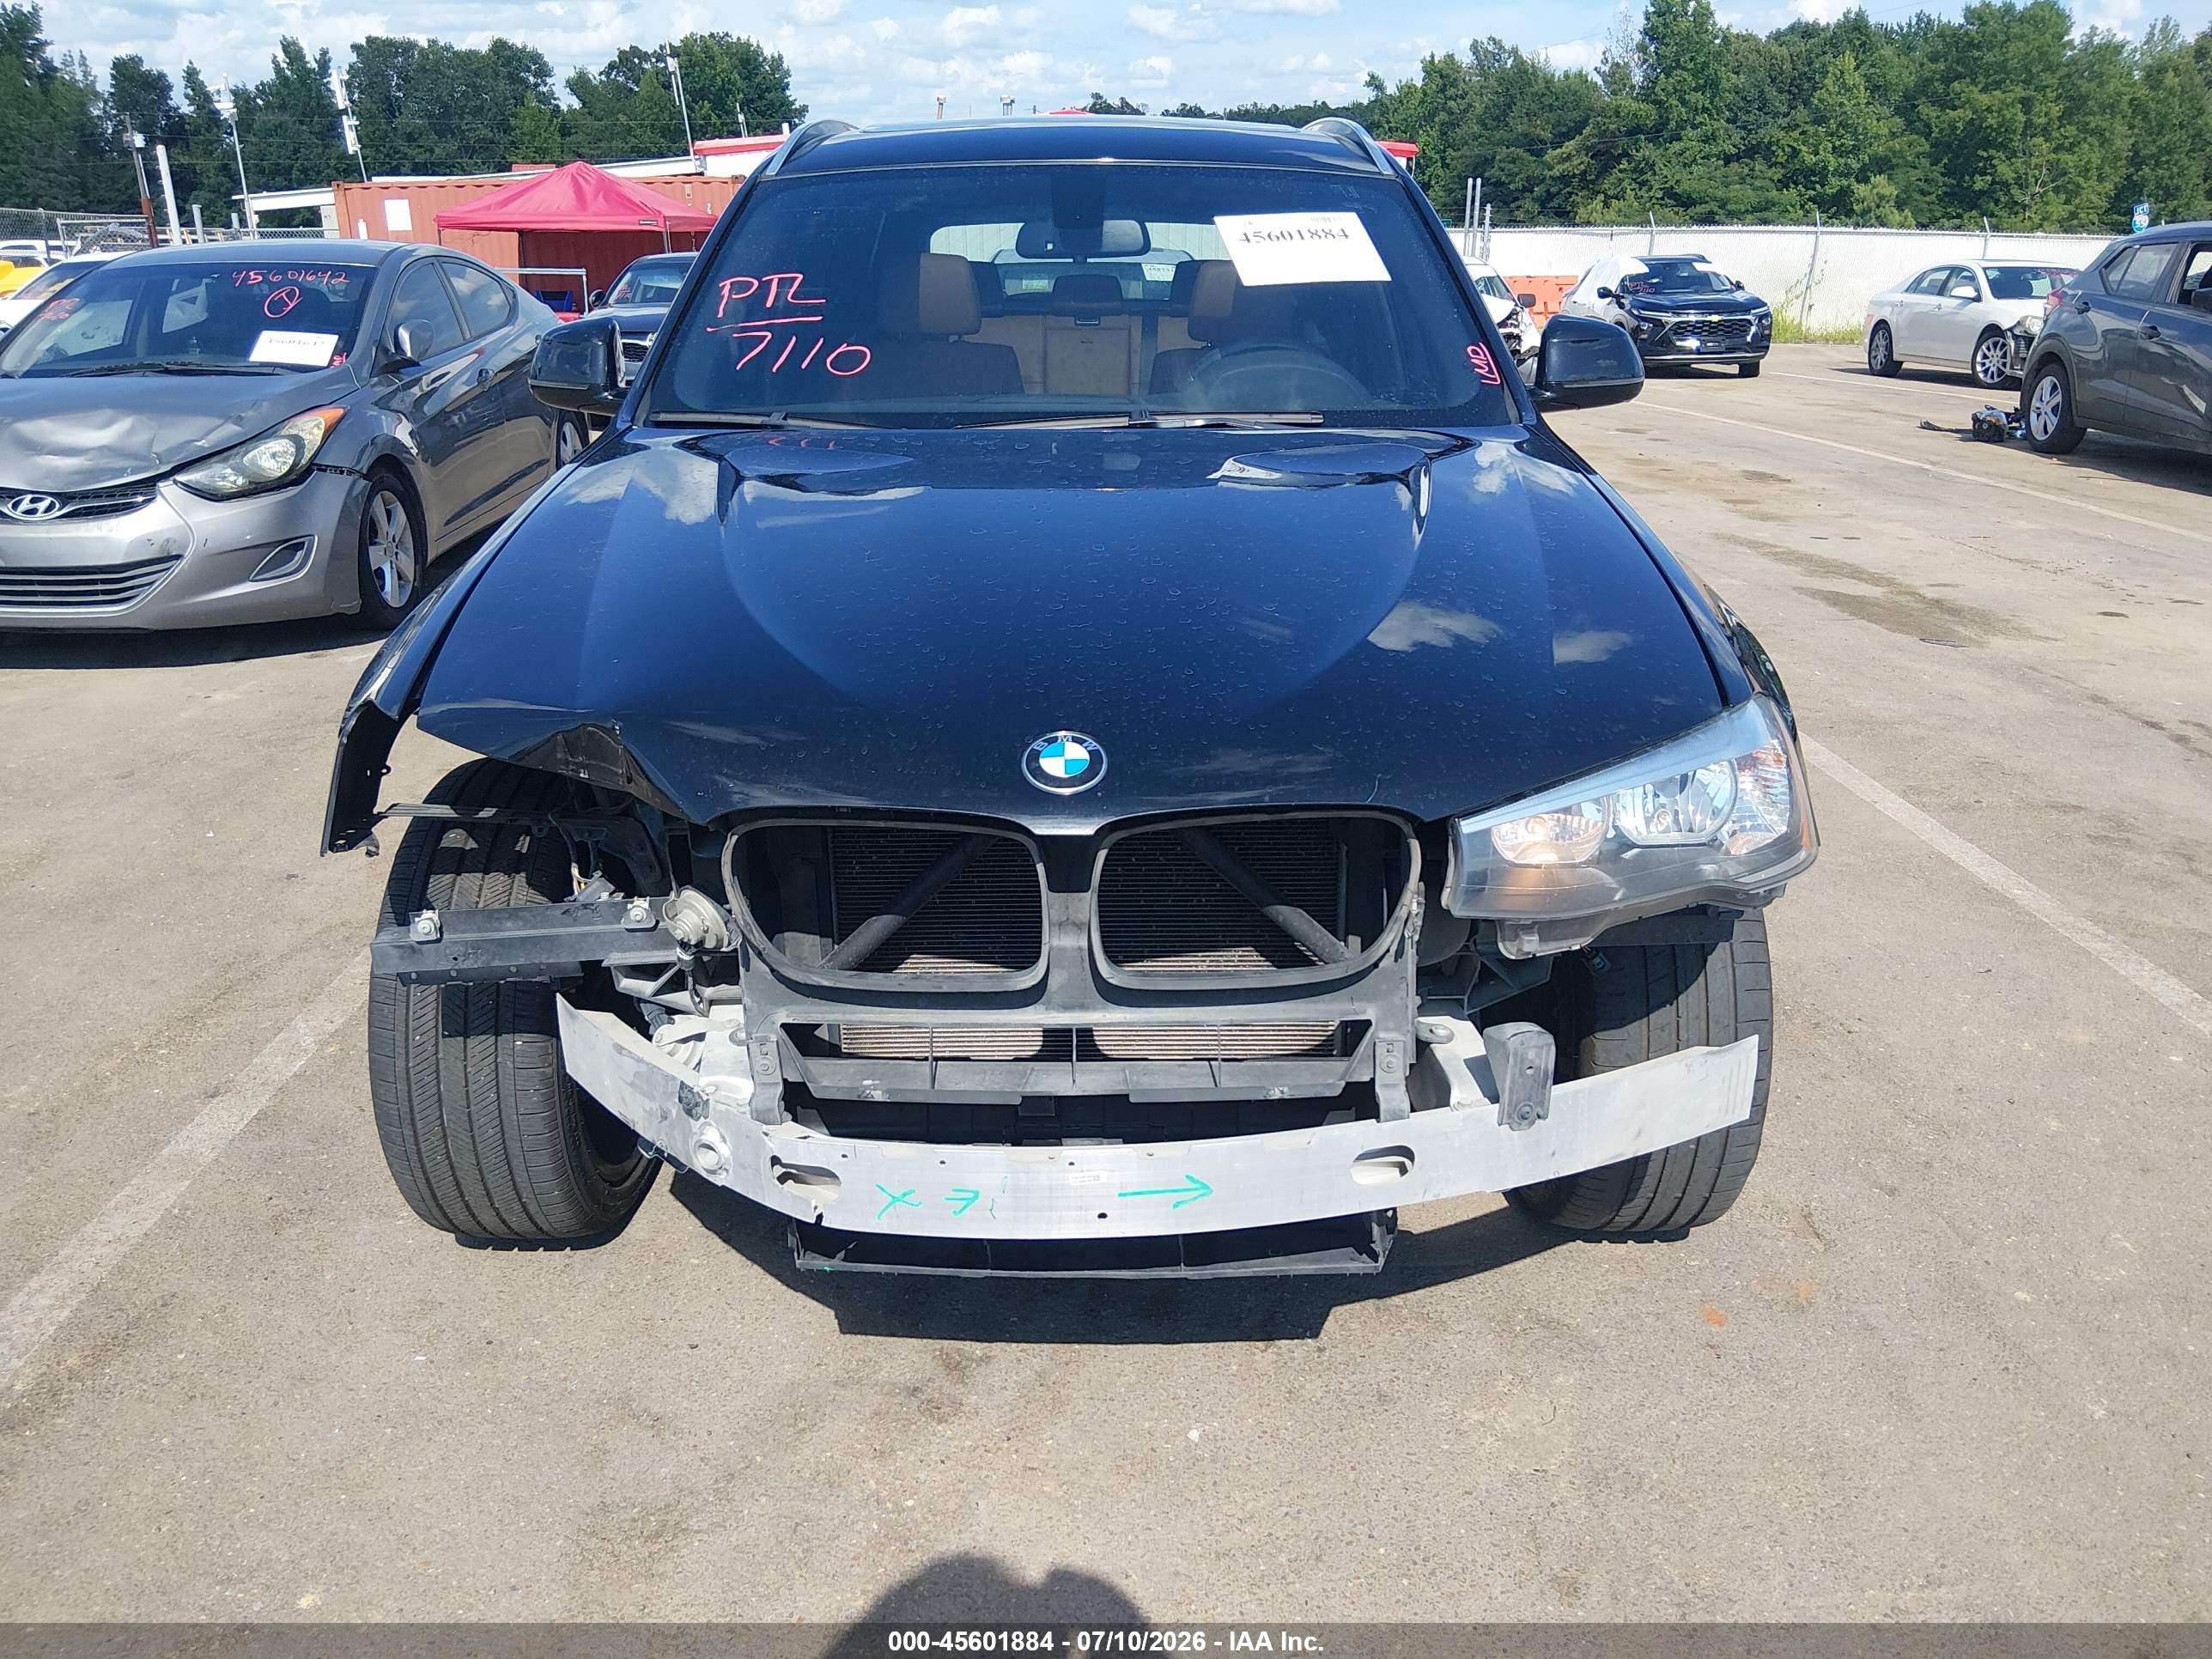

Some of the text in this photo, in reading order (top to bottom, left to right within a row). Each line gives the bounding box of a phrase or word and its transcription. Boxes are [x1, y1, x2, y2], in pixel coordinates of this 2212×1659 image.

[2136, 205, 2148, 215] JCT
[1239, 228, 1349, 244] 45601884
[233, 270, 350, 287] 45601642
[732, 331, 871, 375] 7110
[1033, 735, 1098, 751] BMW
